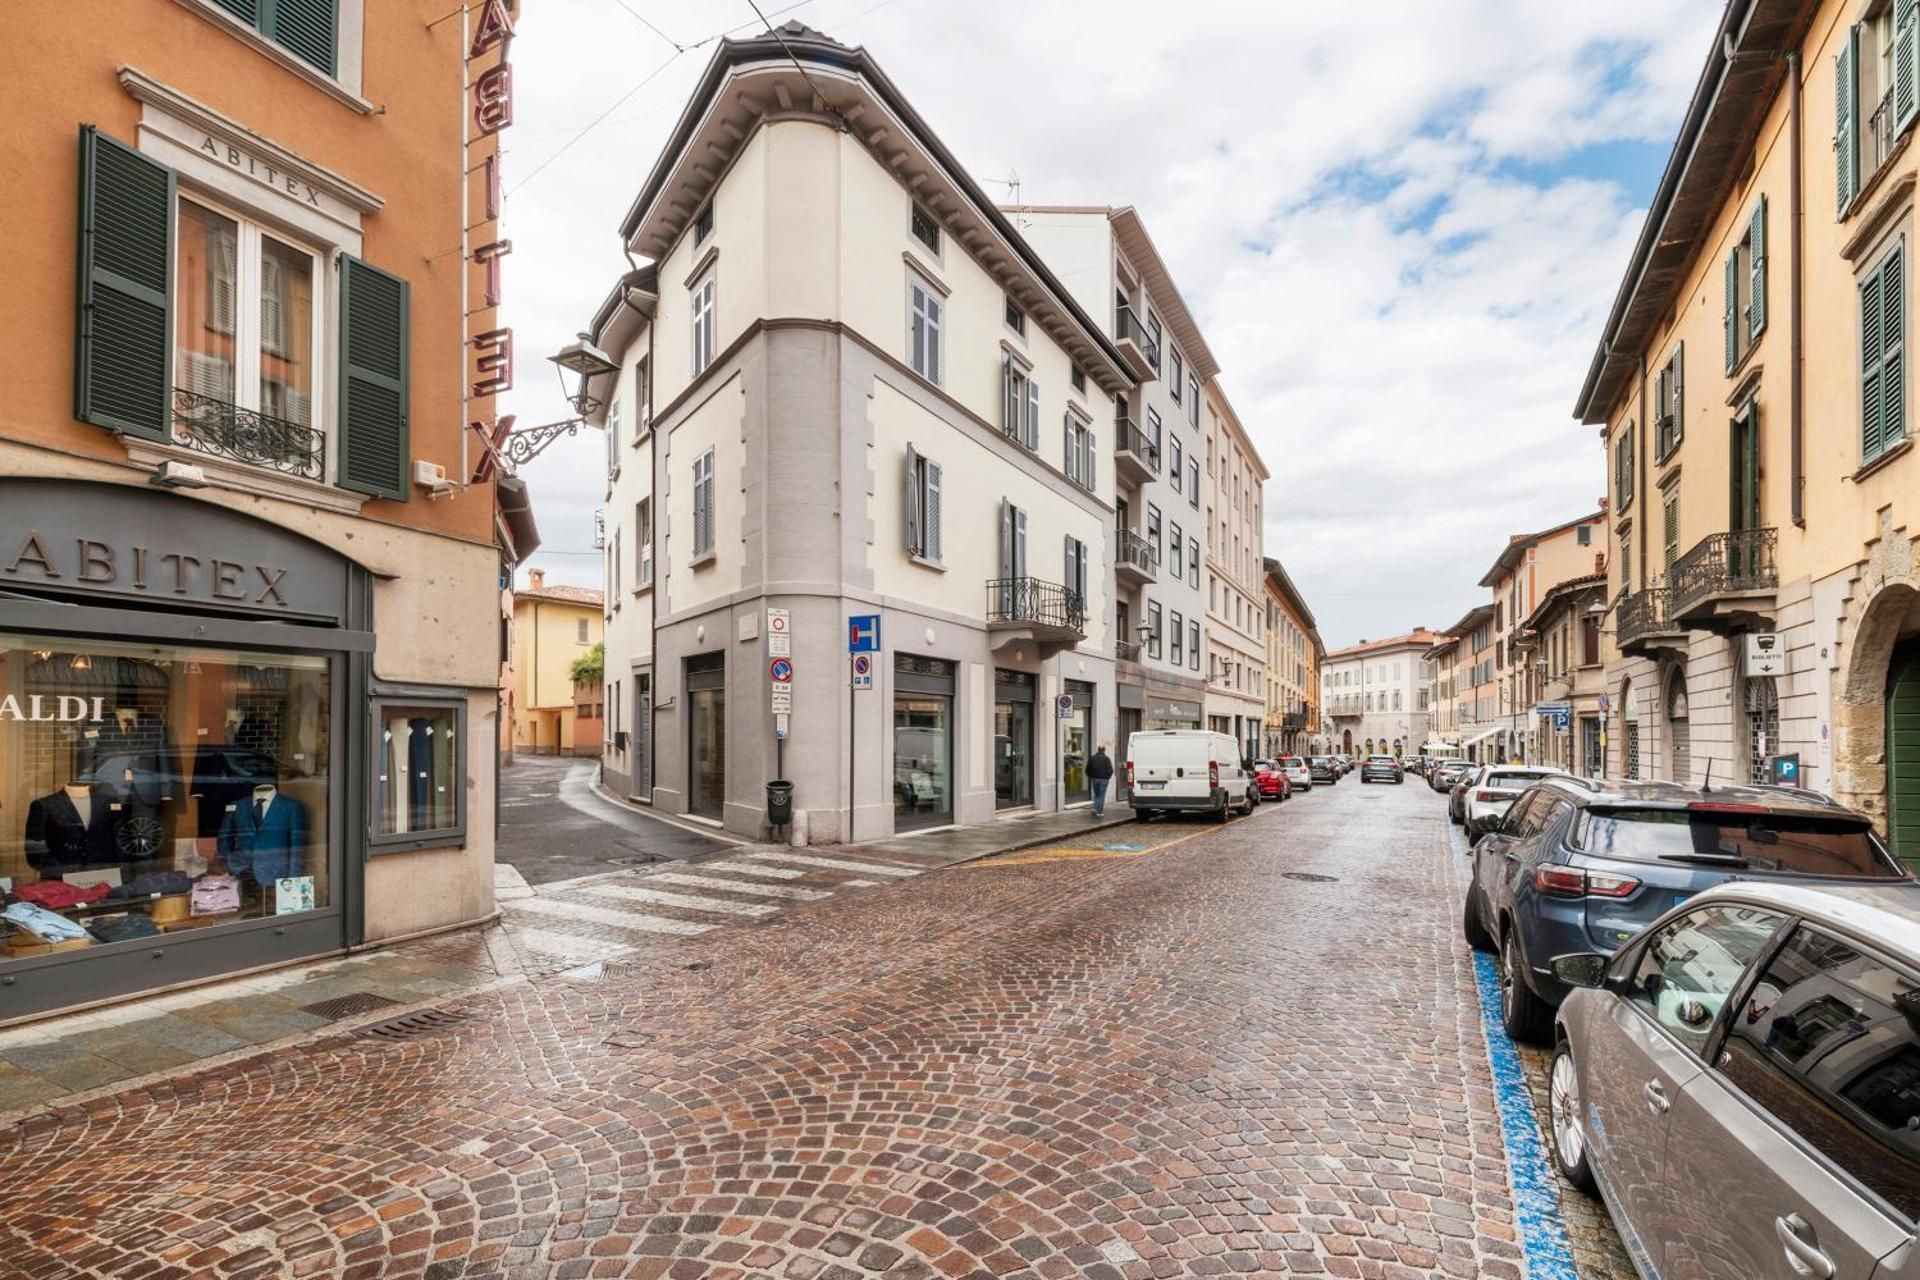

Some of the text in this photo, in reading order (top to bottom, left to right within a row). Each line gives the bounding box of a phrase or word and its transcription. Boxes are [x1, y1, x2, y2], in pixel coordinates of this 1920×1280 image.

[201, 137, 320, 207] ABITEX
[5, 528, 288, 606] ABITEX
[0, 694, 105, 722] ALDI
[1558, 716, 1566, 725] P
[1782, 762, 1794, 775] P
